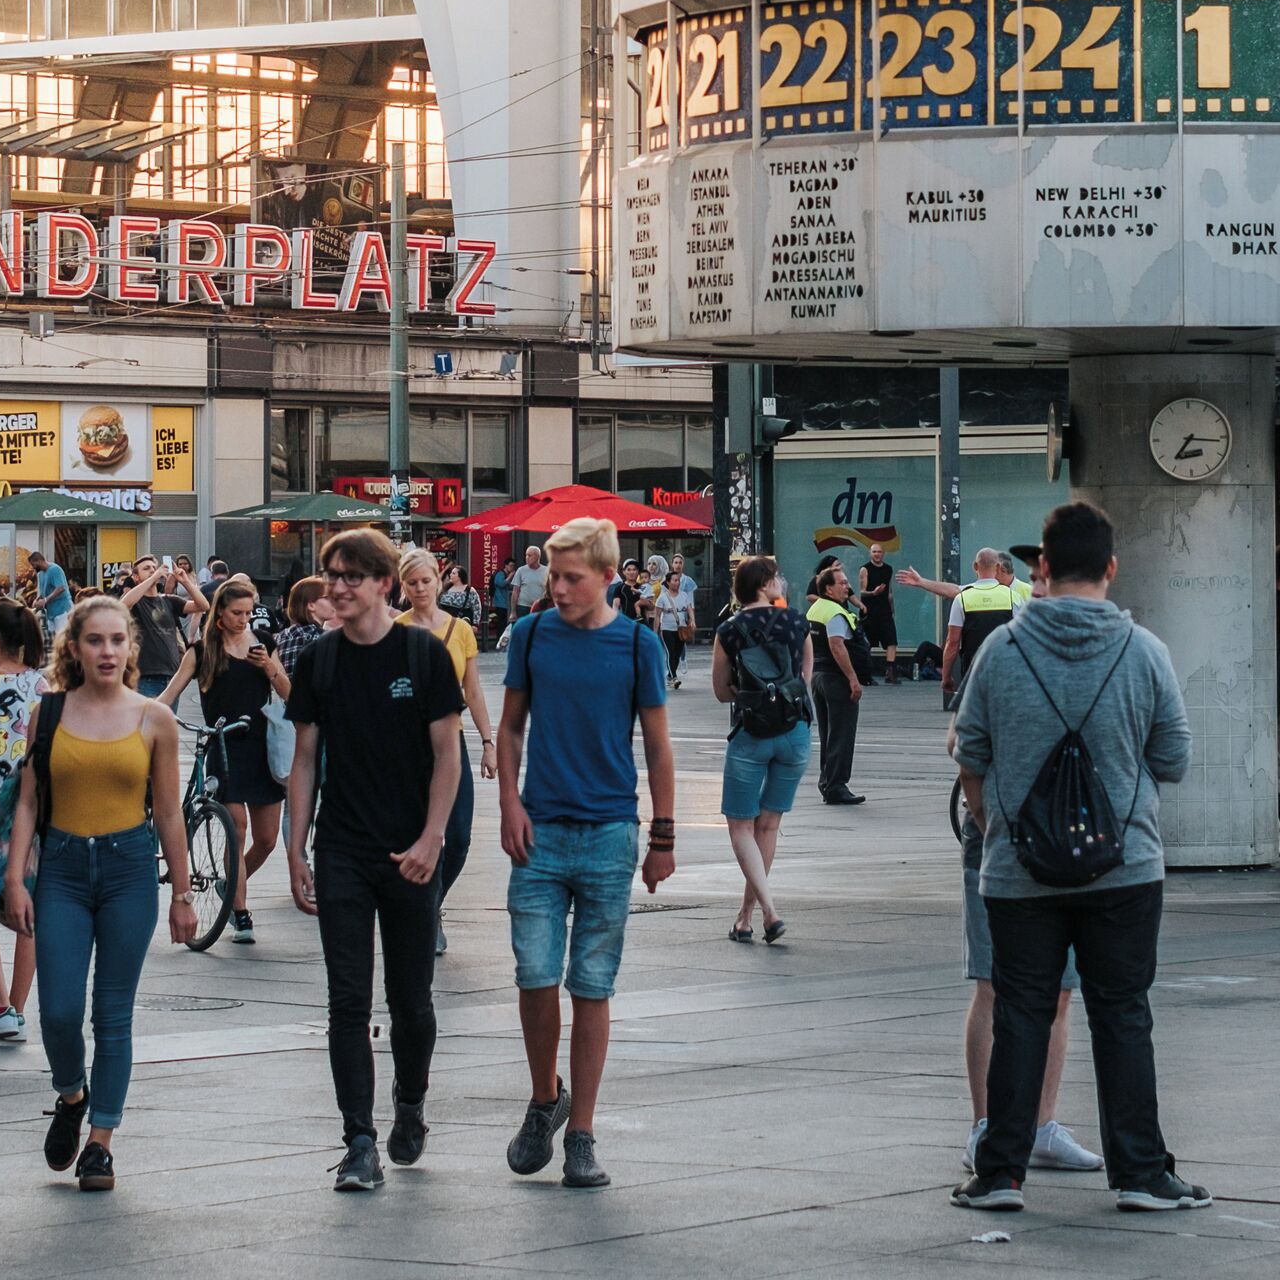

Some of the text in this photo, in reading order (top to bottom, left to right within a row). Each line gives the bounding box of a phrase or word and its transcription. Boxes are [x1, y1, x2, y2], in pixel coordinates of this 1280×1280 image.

[866, 9, 977, 97] 23
[1000, 6, 1121, 91] 24
[1184, 5, 1231, 89] 1
[760, 19, 848, 108] 22
[687, 30, 740, 117] 21
[691, 167, 729, 183] ANKARA
[770, 160, 827, 176] TEHERAN
[690, 184, 730, 201] ISTANBUL
[789, 178, 838, 193] BAGDAD
[906, 190, 953, 206] KABUL
[1036, 187, 1125, 202] NEW DELHI
[696, 203, 724, 218] ATHEN
[797, 196, 831, 210] ADEN
[908, 208, 987, 224] MAURITIUS
[1062, 205, 1139, 219] KARACHI
[692, 220, 729, 236] TEL AVIV
[790, 214, 836, 229] SANAA
[1044, 224, 1116, 239] COLOMBO
[1206, 223, 1275, 237] RANGUN
[687, 237, 734, 254] JERUSALEM
[772, 231, 856, 248] ADDIS ABEBA
[696, 256, 724, 271] BEIRUT
[772, 249, 855, 266] MOGADISCHU
[688, 273, 734, 289] DAMASKUS
[772, 267, 856, 284] DARESSALAM
[697, 291, 723, 306] KAIRO
[764, 284, 864, 302] ANTANANARIVO
[689, 309, 732, 325] KAPSTADT
[791, 304, 837, 319] KUWAIT
[6, 431, 55, 448] MITTE?
[156, 428, 175, 441] ICH
[156, 441, 189, 456] LIEBE
[157, 457, 176, 470] ES!
[831, 477, 893, 525] dm
